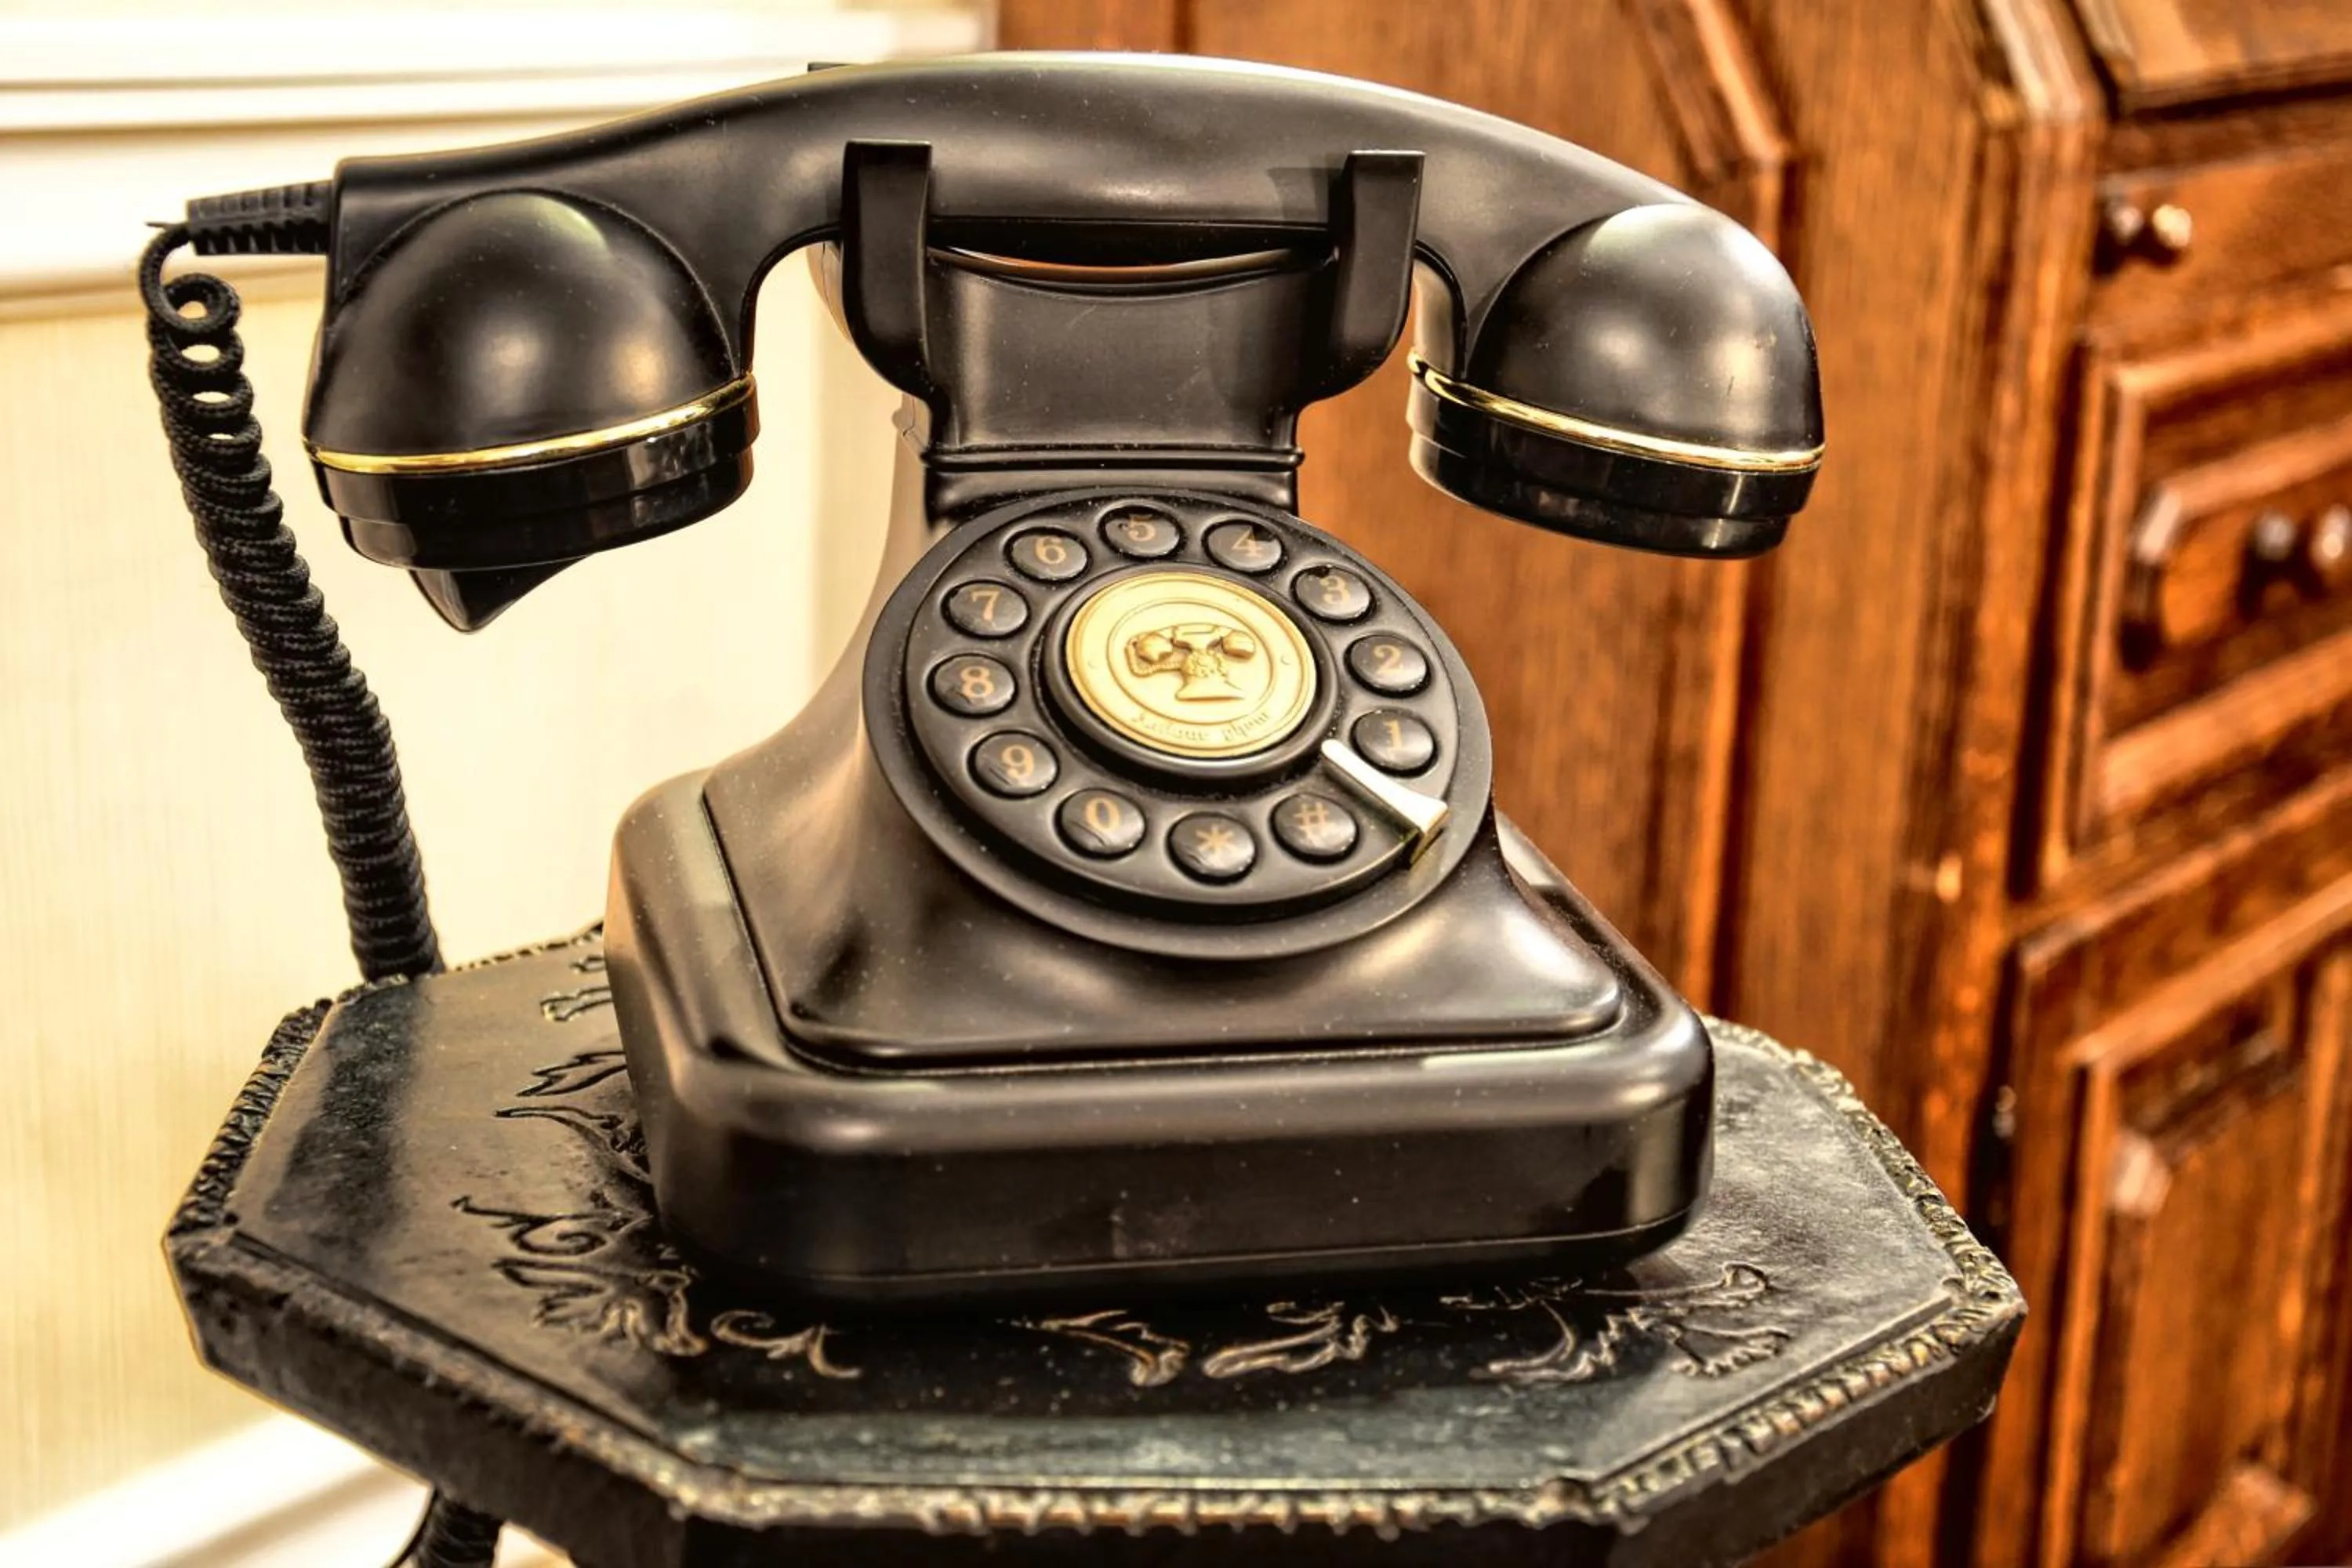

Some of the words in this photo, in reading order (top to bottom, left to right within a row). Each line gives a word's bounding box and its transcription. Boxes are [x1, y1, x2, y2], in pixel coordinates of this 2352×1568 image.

[1127, 513, 1156, 543] 5
[1232, 526, 1268, 557] 4
[1035, 535, 1067, 564] 6
[971, 590, 1000, 621] 7
[1319, 575, 1352, 605] 3
[1374, 644, 1404, 675] 2
[960, 665, 995, 699] 8
[1382, 719, 1403, 758] 1
[1001, 745, 1035, 779] 9
[1085, 797, 1121, 832] 0
